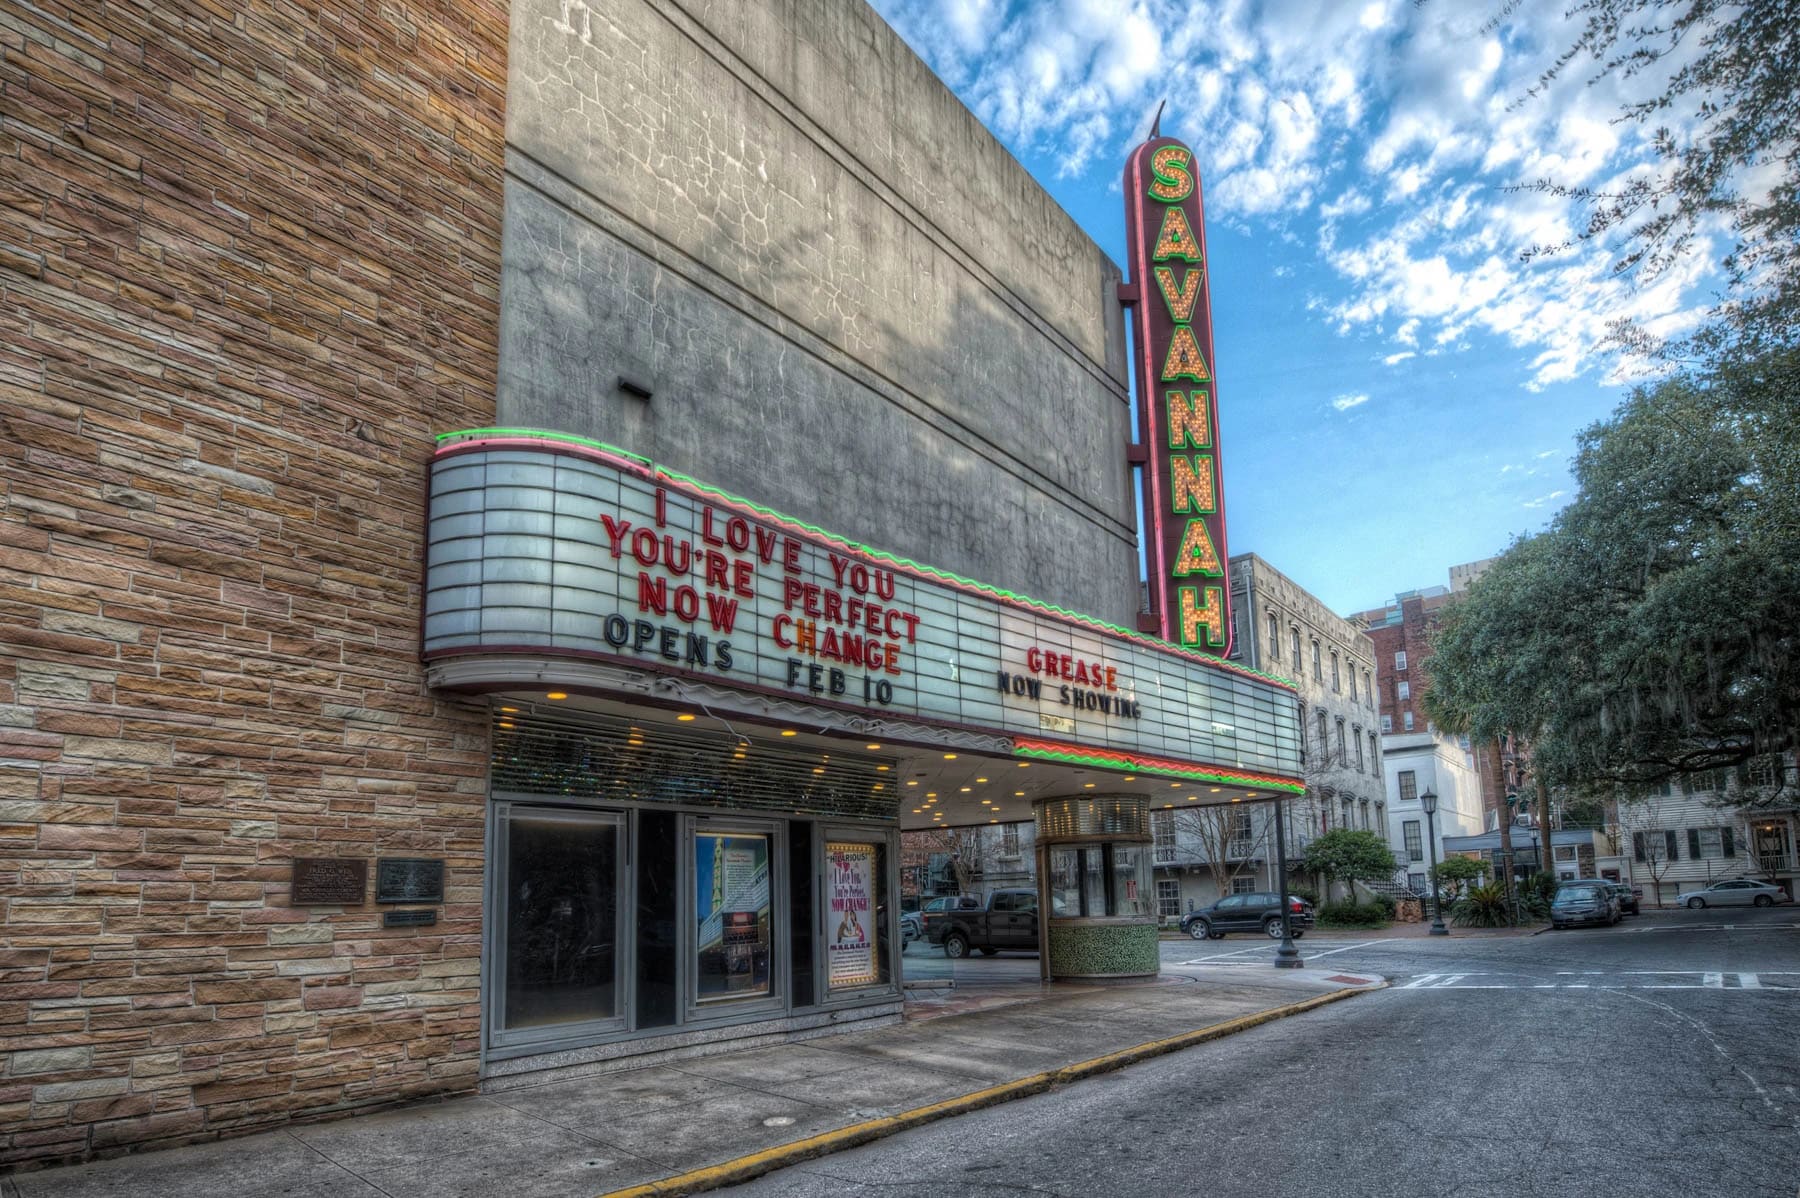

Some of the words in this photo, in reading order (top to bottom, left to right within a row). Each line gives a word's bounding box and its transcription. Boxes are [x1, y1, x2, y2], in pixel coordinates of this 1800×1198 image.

[1147, 144, 1226, 648] SAVANNAH
[600, 513, 754, 599] YOU'RE
[784, 575, 921, 644] PERFECT
[655, 487, 666, 528] I
[703, 506, 802, 575] LOVE
[829, 553, 896, 602] YOU
[603, 613, 733, 671] OPENS
[787, 657, 846, 696] FEB
[638, 571, 739, 634] NOW
[773, 613, 902, 676] CHANGE
[1027, 646, 1118, 692] GREASE
[997, 670, 1042, 701] NOW
[1060, 684, 1142, 720] SHOWING
